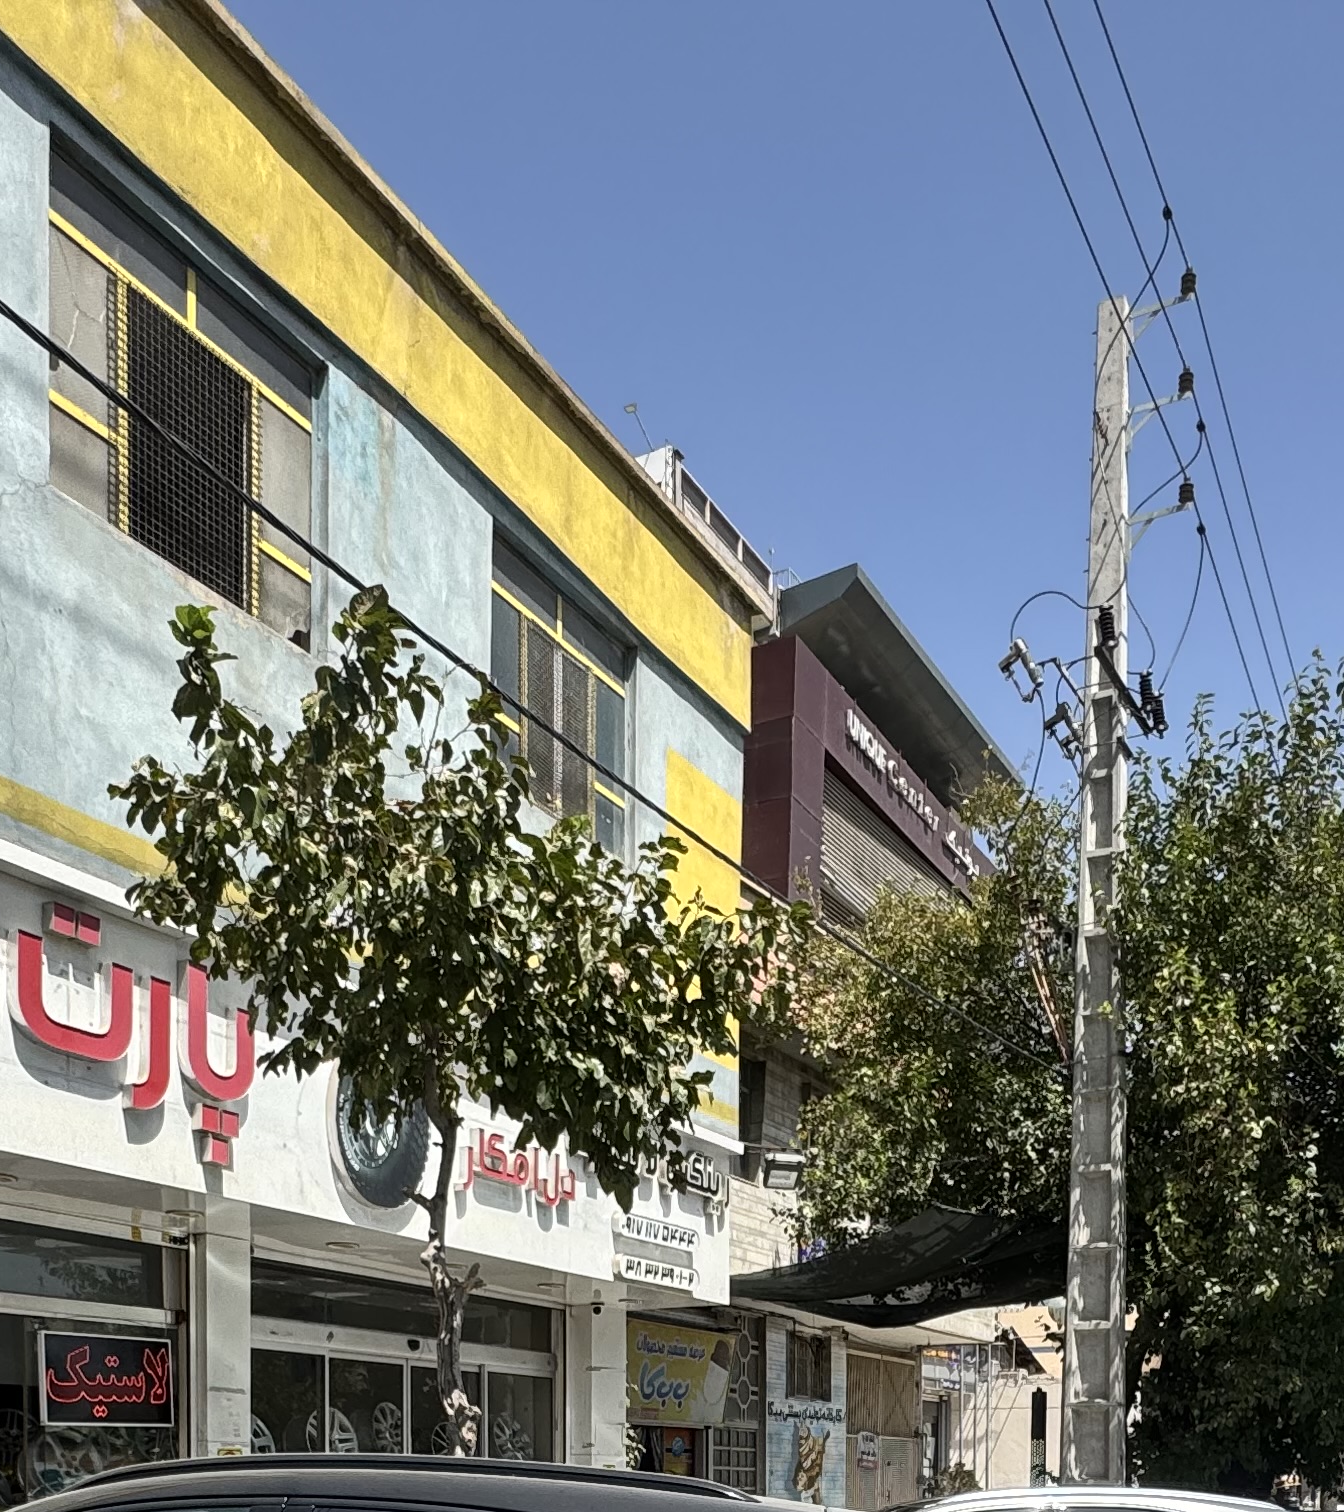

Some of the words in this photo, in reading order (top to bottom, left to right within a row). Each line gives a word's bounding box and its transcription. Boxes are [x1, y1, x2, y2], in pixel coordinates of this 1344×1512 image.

[846, 708, 887, 774] UNIQUE
[887, 759, 940, 832] Center
[12, 897, 254, 1167] پارت
[47, 1344, 170, 1418] لاستیک
